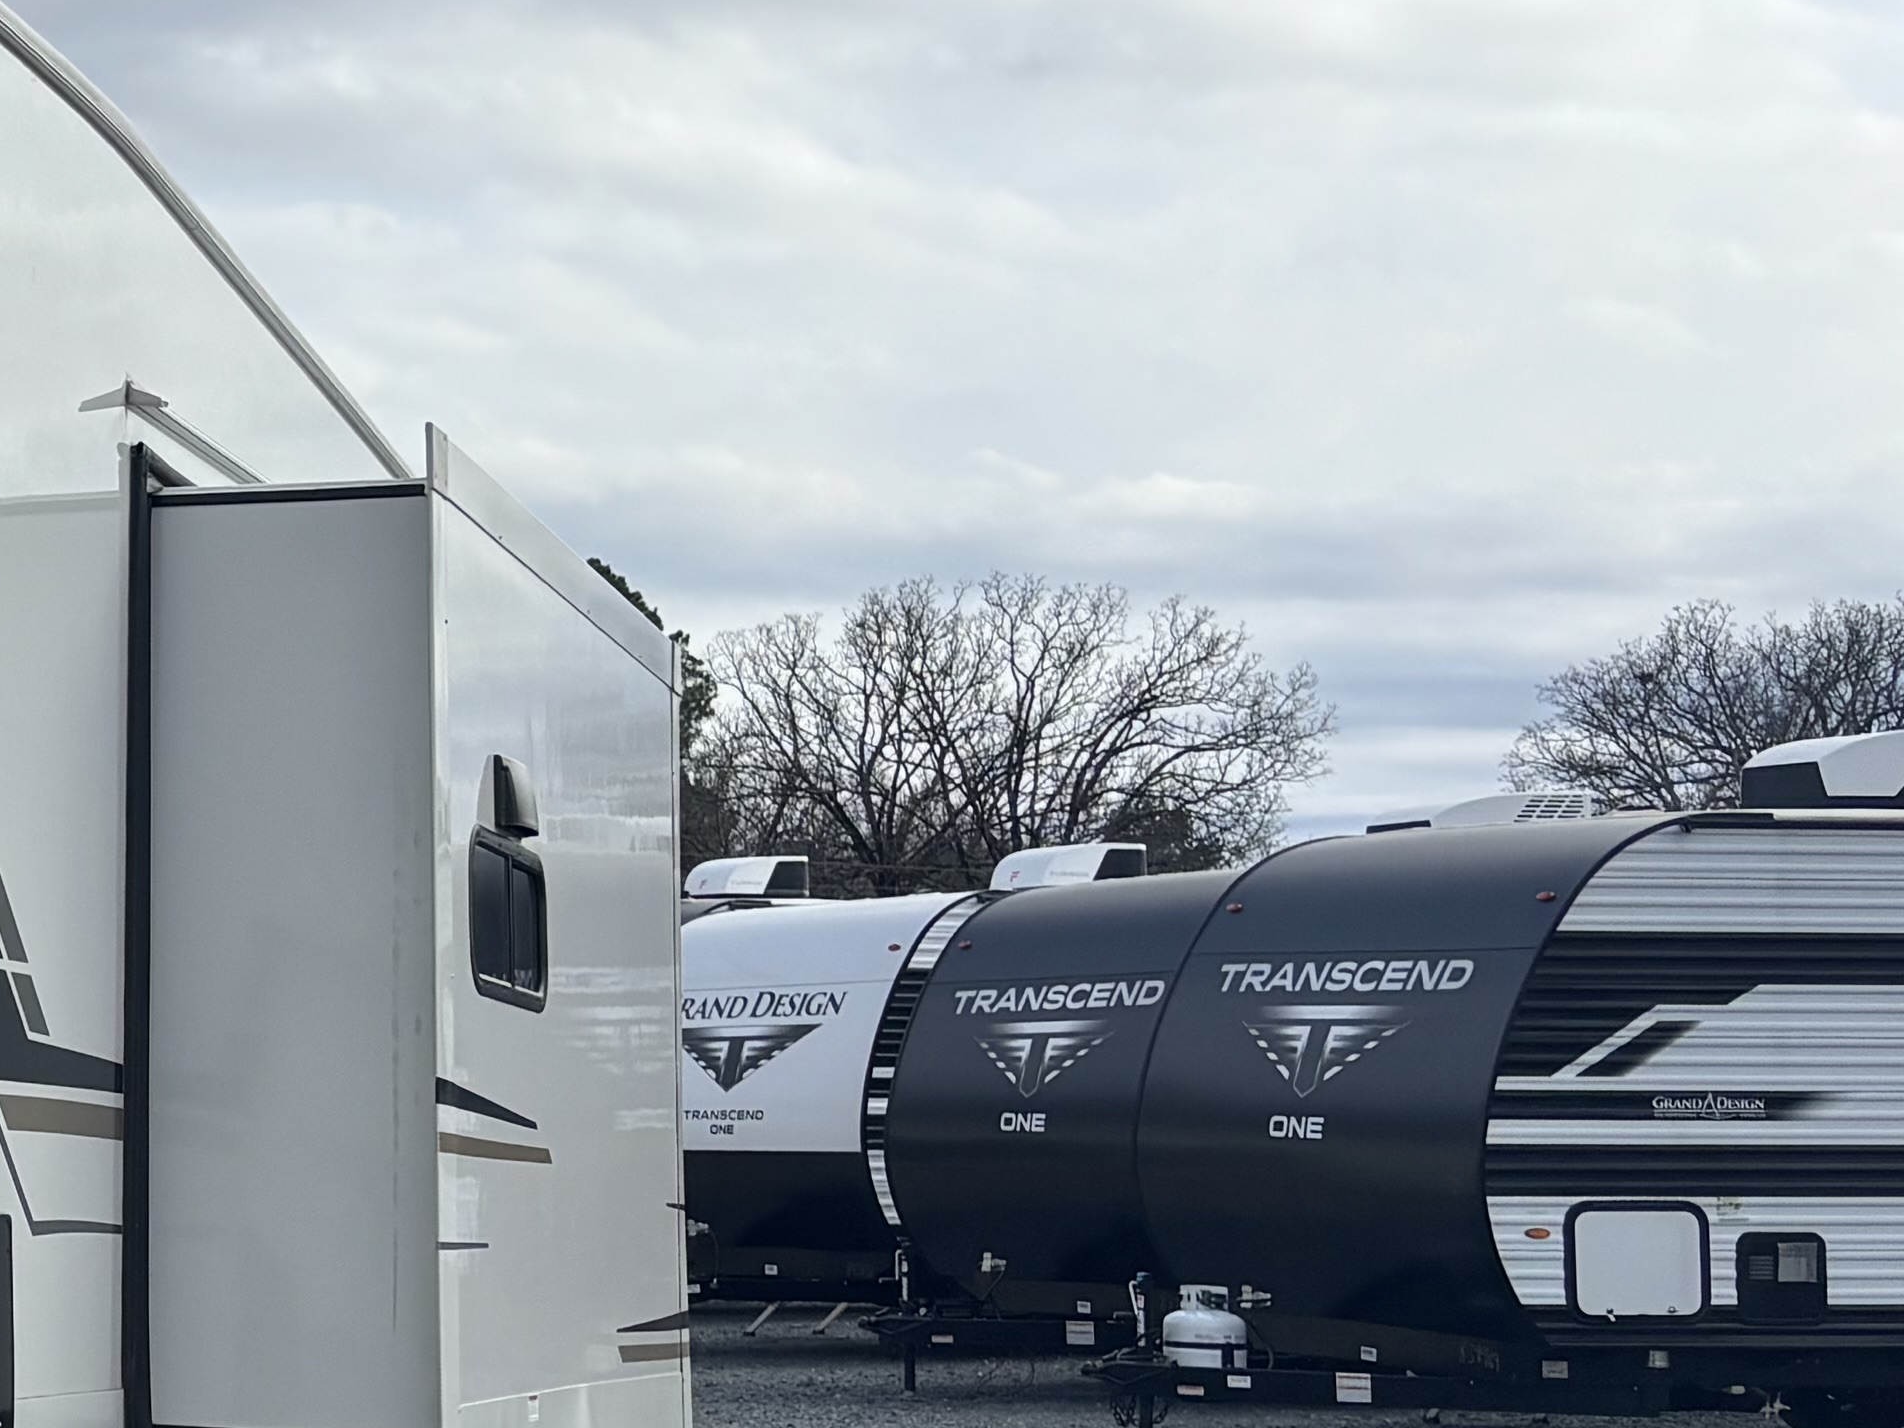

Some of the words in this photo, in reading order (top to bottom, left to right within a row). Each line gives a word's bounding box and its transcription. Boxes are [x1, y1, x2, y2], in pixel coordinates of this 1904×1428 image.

[1220, 959, 1474, 992] TRANSCEND
[682, 995, 749, 1020] RAND
[749, 990, 848, 1018] DESIGN
[954, 979, 1166, 1015] TRANSCEND
[1652, 1095, 1703, 1109] GRAND
[1716, 1096, 1765, 1109] DESIGN
[683, 1109, 765, 1121] TRANSCEND
[1000, 1112, 1047, 1133] ONE
[709, 1124, 734, 1135] ONE
[1268, 1115, 1325, 1139] ONE
